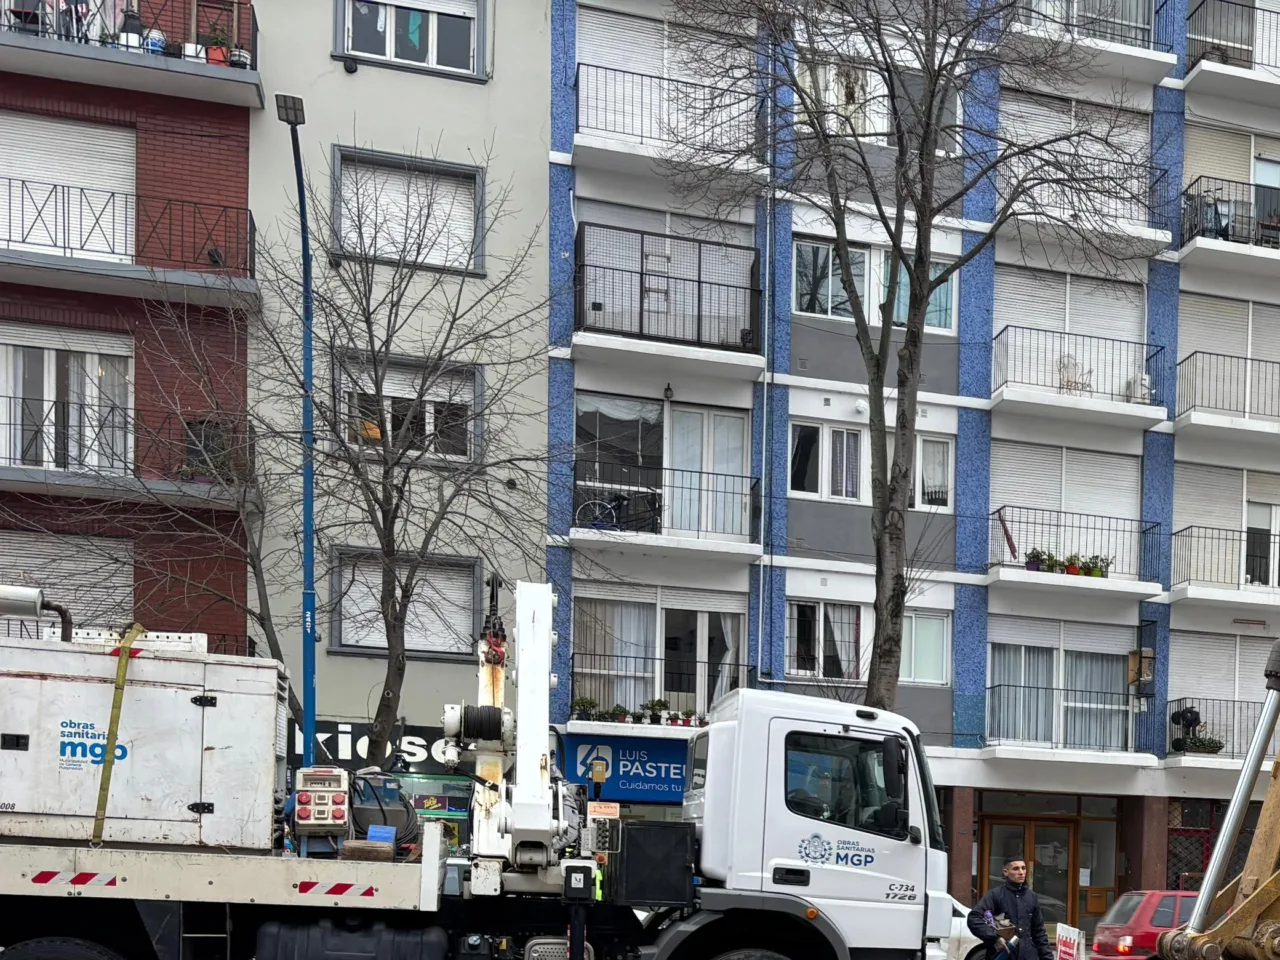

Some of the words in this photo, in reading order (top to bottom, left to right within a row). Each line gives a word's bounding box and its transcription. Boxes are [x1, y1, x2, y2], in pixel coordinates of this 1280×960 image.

[60, 720, 95, 730] obras
[60, 730, 119, 741] sanitaris
[620, 750, 648, 760] LUIS
[620, 761, 686, 779] PASTE
[618, 780, 669, 791] Cuidamos
[836, 845, 876, 853] SANITARIAS
[835, 852, 875, 867] MGP
[889, 884, 915, 892] C-734
